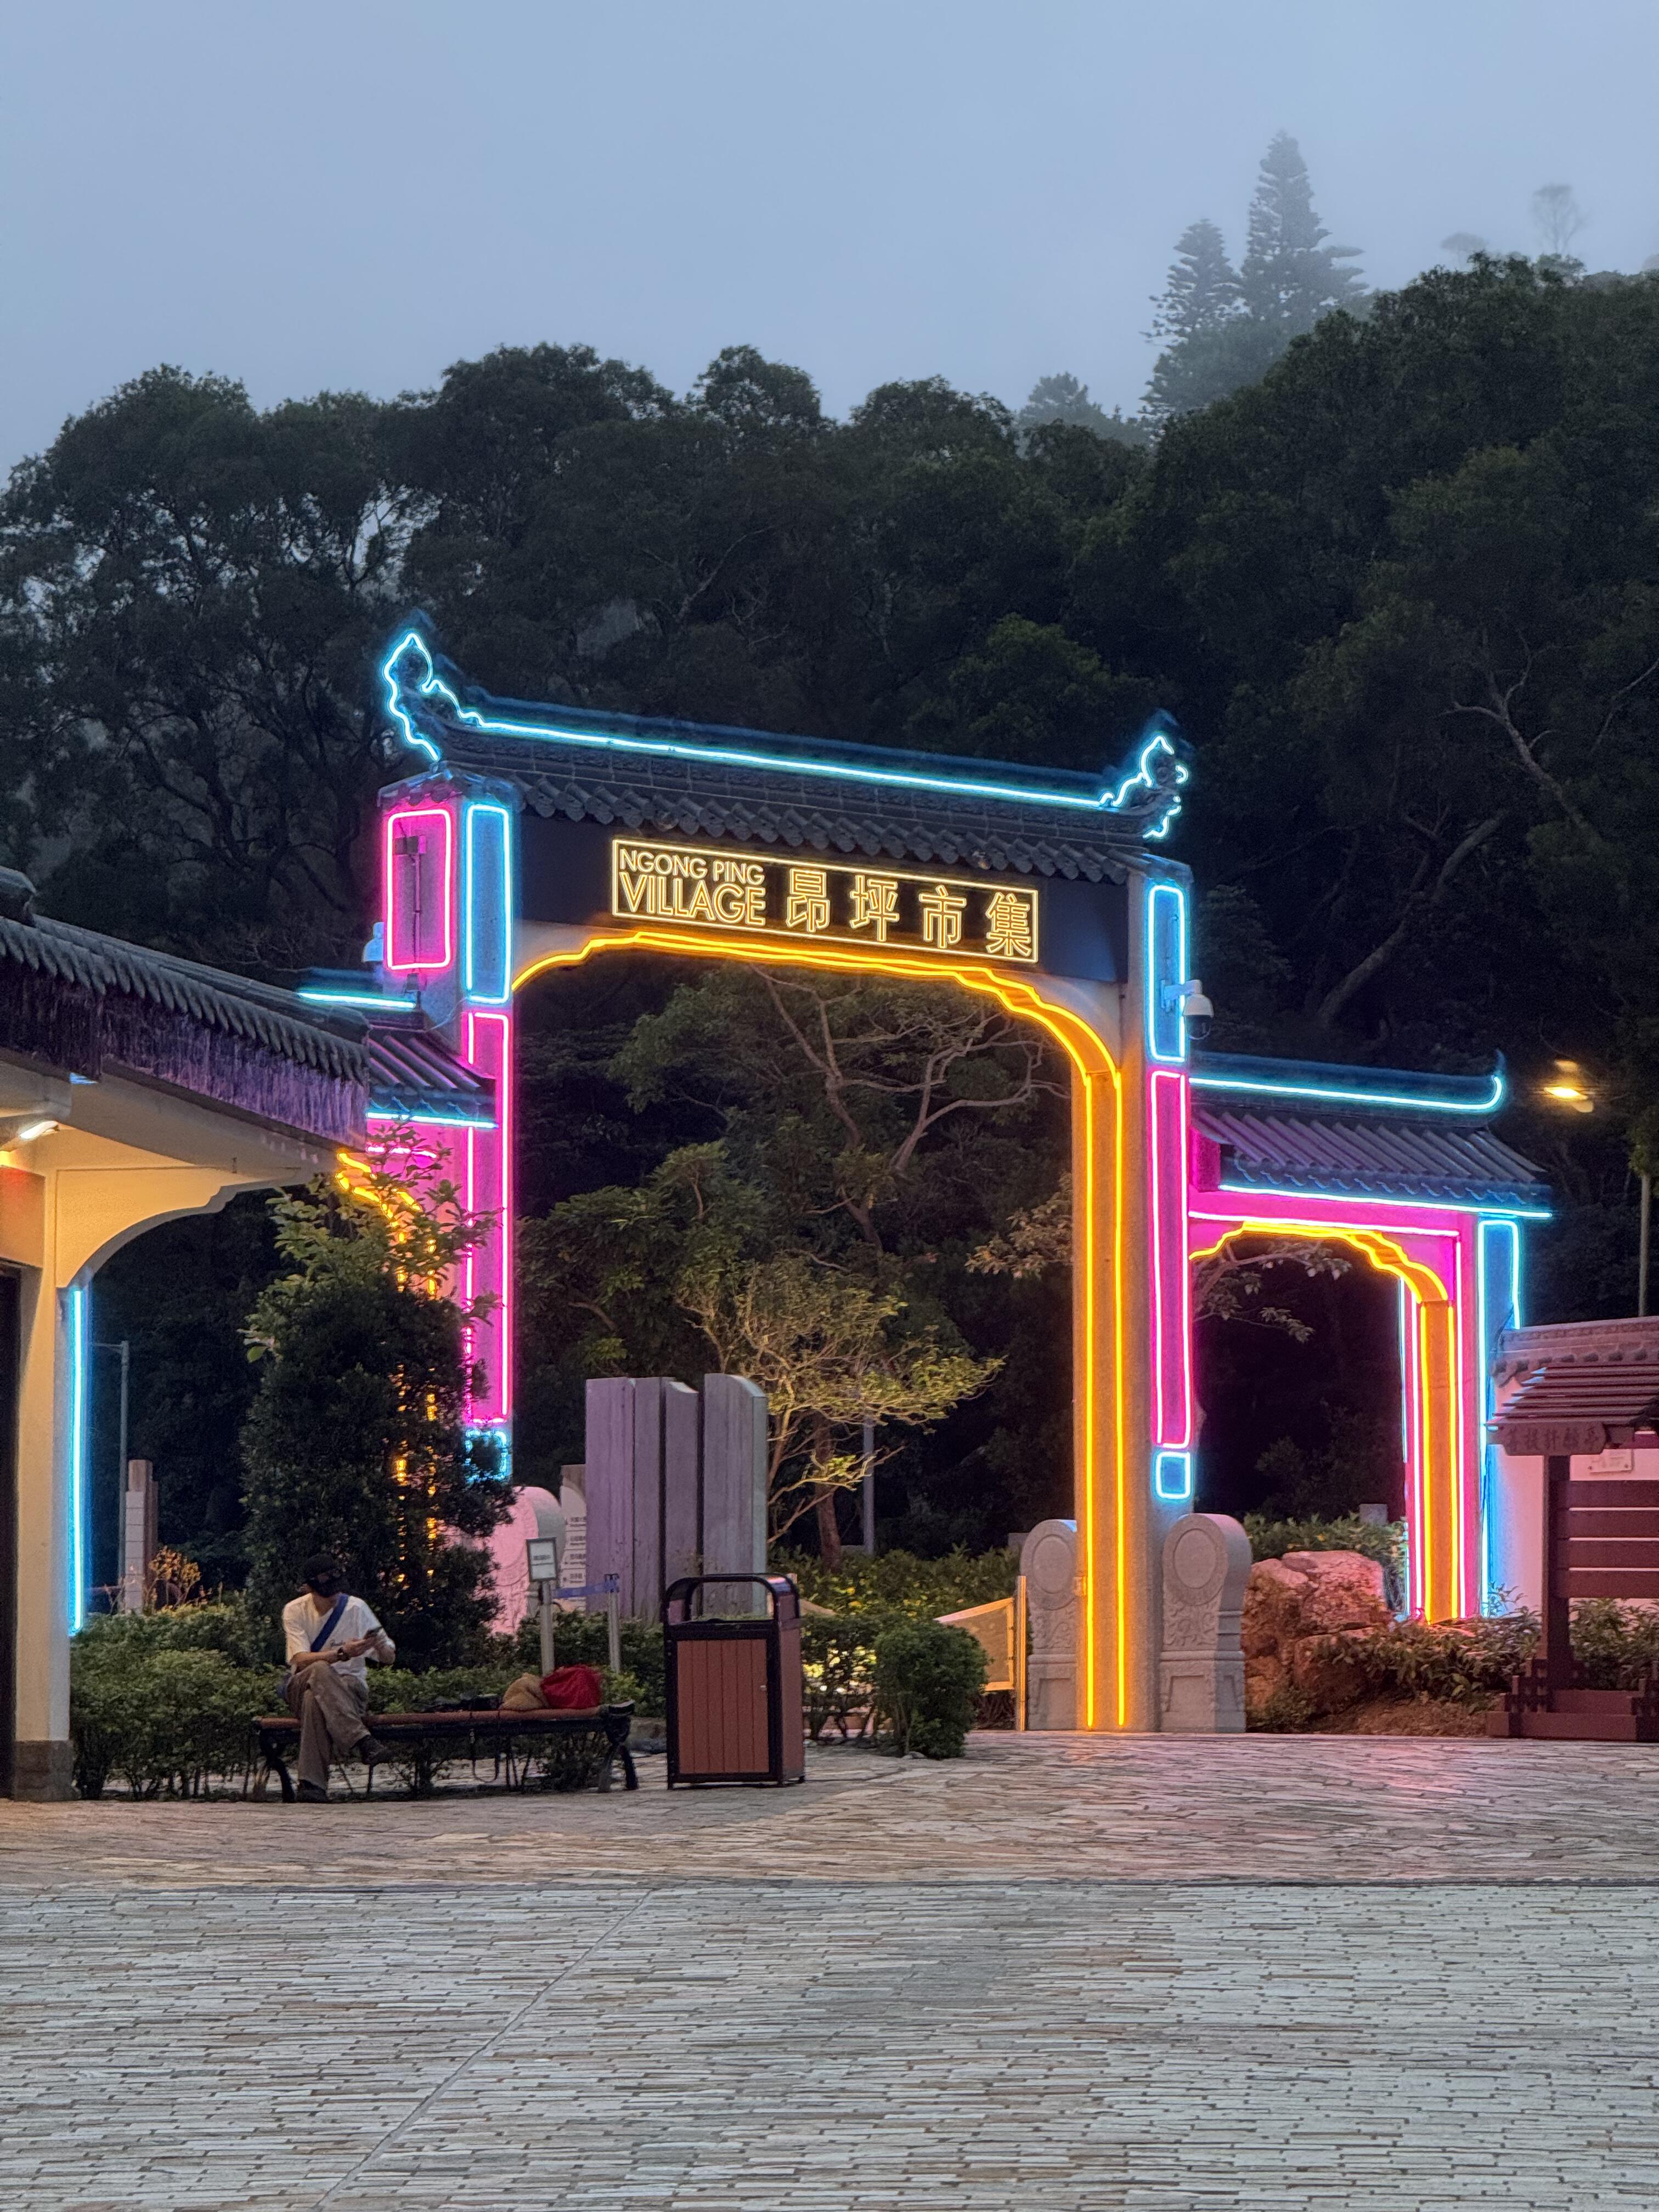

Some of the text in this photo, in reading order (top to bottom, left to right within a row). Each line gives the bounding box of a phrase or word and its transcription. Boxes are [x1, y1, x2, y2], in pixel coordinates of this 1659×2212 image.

[619, 848, 765, 885] NGONG PING
[619, 871, 766, 926] VILLAGE
[786, 868, 1032, 957] 昂坪市集
